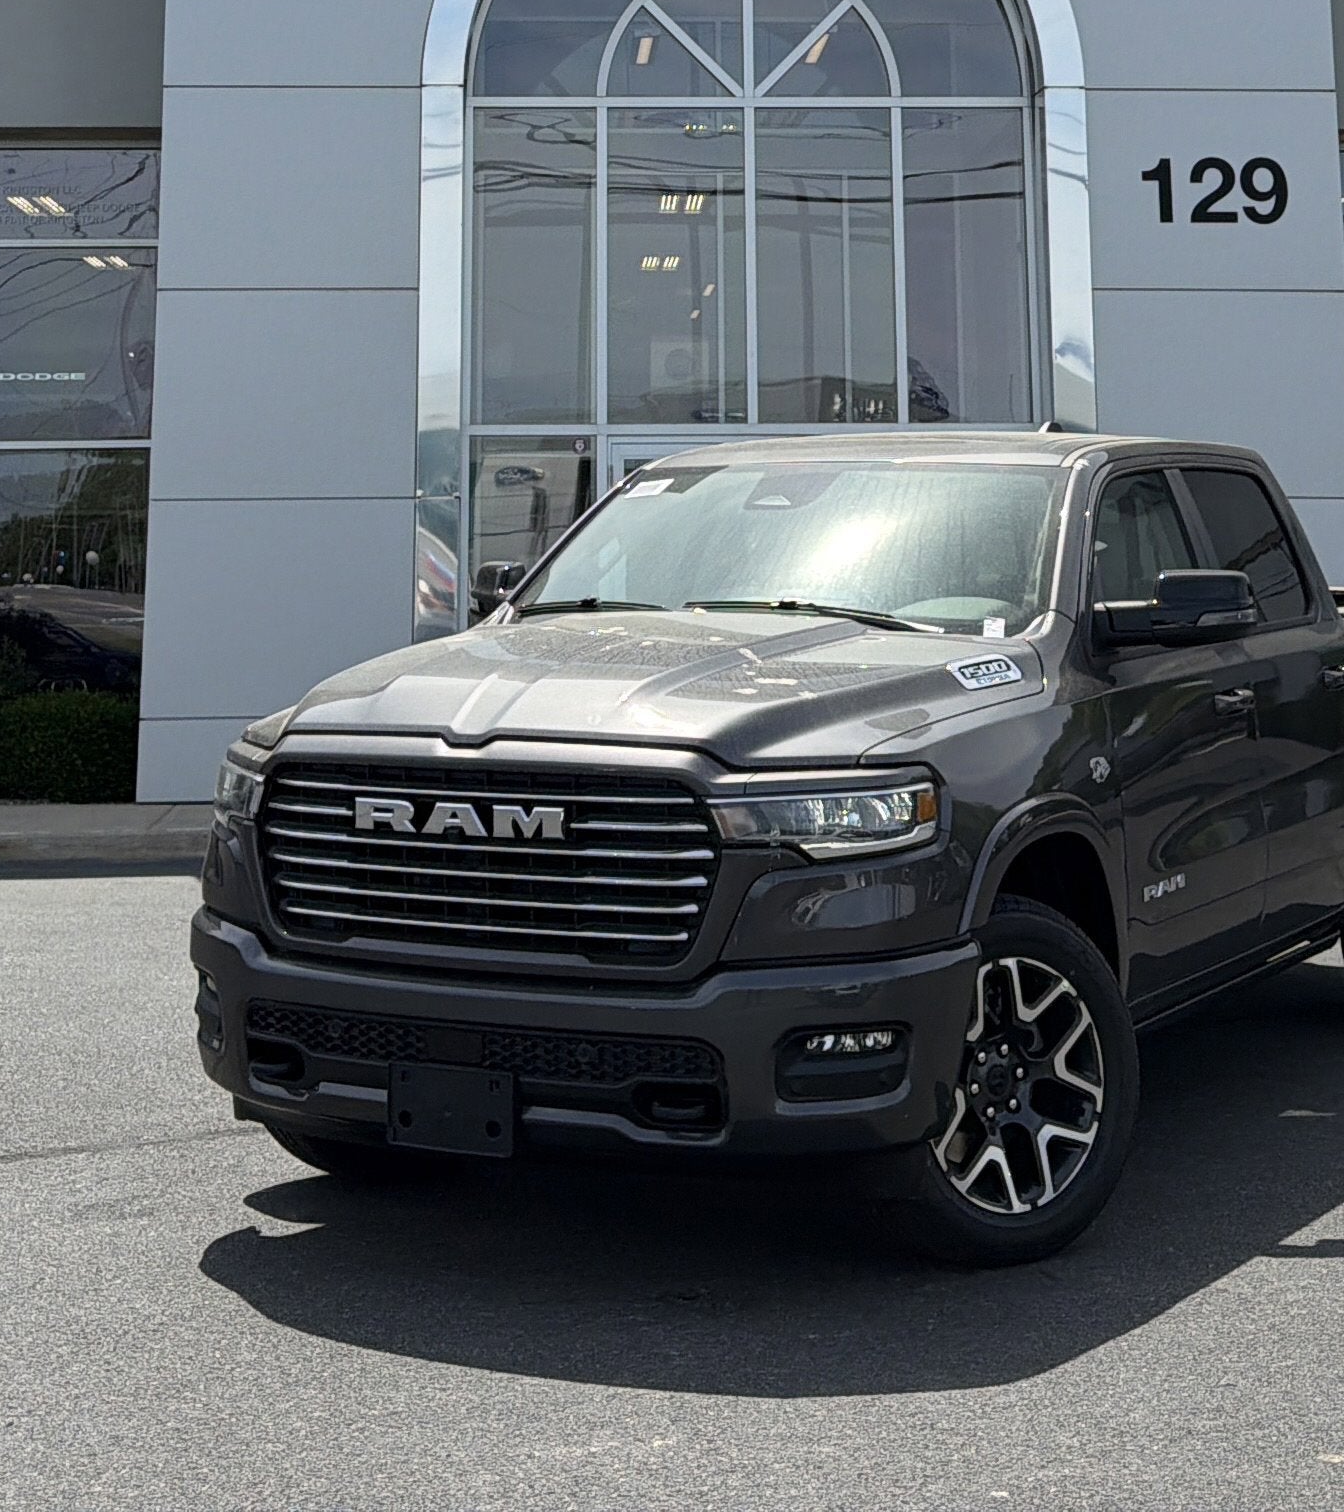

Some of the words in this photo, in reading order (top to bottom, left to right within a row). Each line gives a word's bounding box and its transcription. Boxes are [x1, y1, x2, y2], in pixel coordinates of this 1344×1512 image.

[1141, 157, 1288, 224] 129
[960, 660, 1008, 679] 1500
[355, 796, 566, 840] RAM
